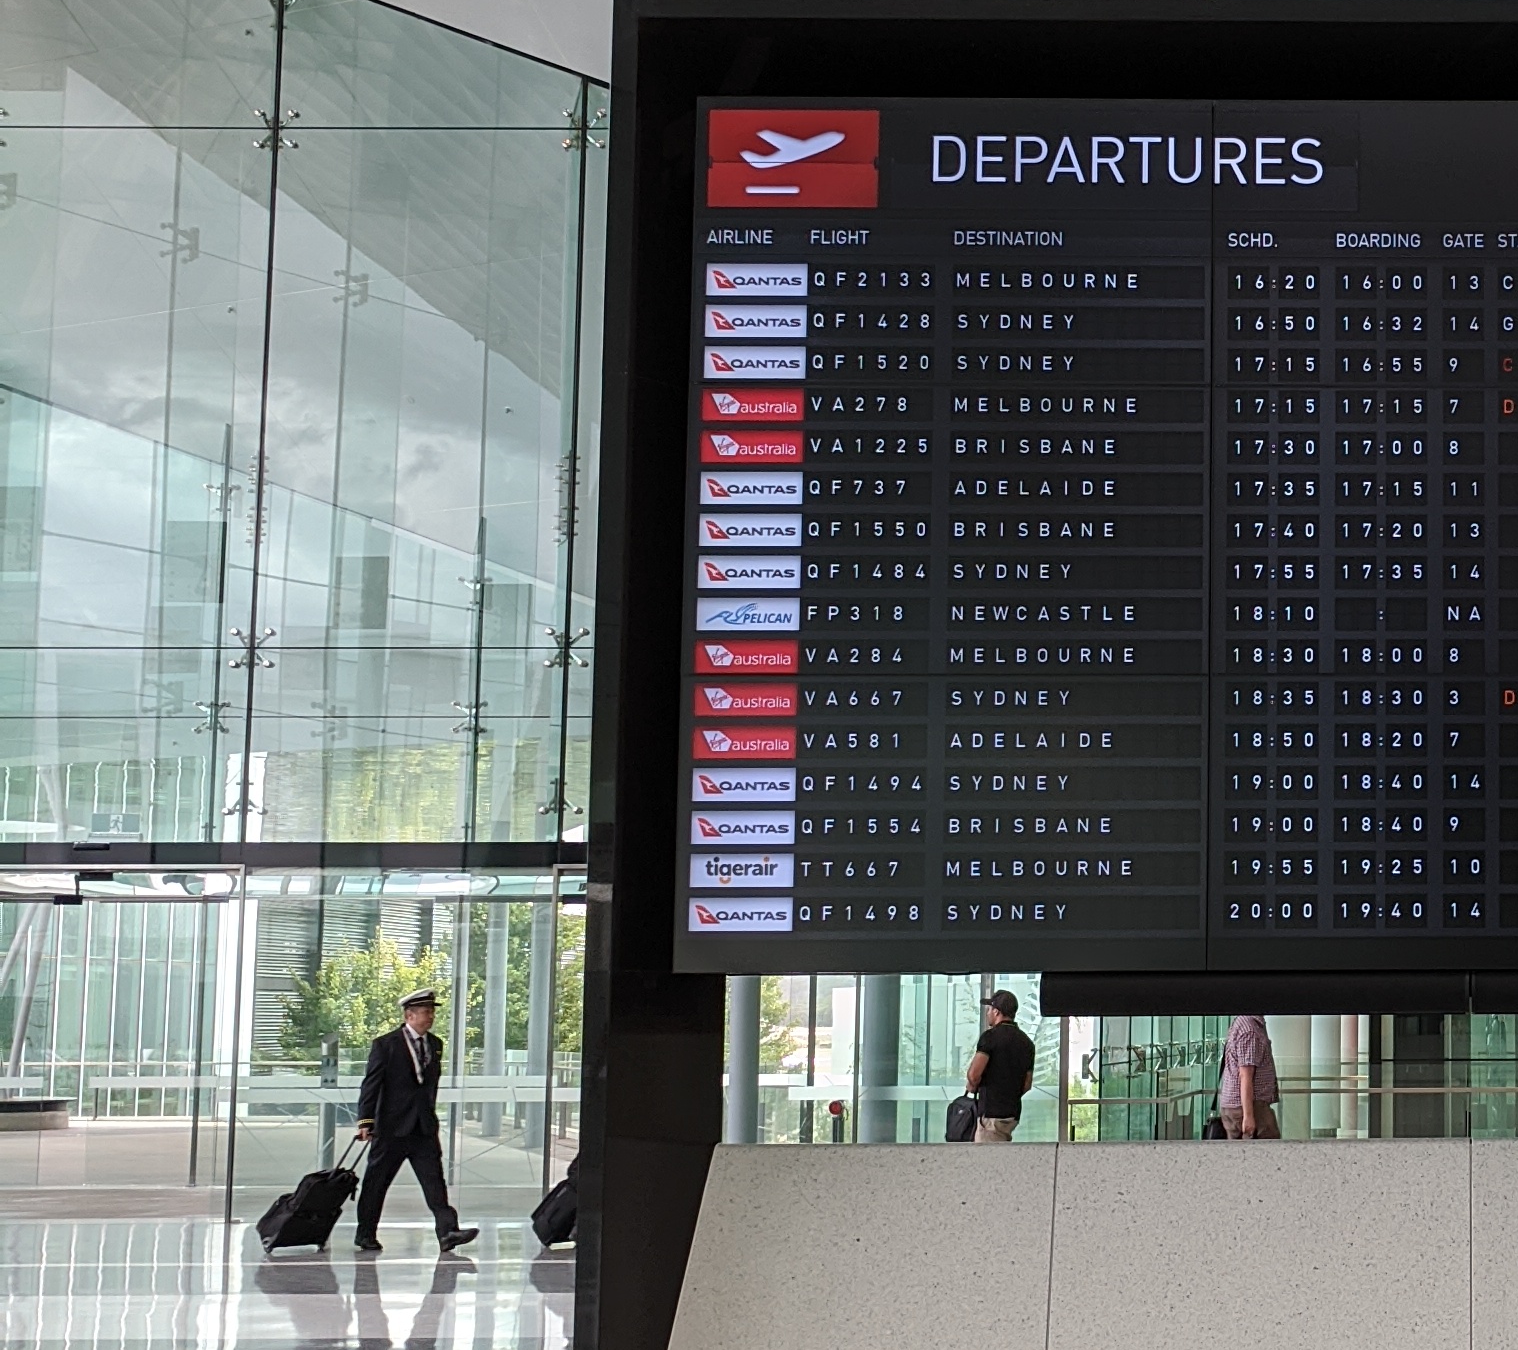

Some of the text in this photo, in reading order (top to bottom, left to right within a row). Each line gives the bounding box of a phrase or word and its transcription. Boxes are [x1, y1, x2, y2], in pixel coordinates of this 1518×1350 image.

[931, 135, 1324, 185] DEPARTURES
[706, 229, 773, 245] AIRLINE
[810, 229, 870, 245] FLIGHT
[954, 230, 1063, 246] DESTINATION
[1228, 232, 1278, 248] SCHD.
[1336, 233, 1421, 248] BOARDING
[1443, 233, 1484, 248] GATE
[733, 275, 803, 287] QANTAS
[814, 271, 930, 287] QF2133
[956, 272, 1138, 289] MELBOURNE
[1235, 274, 1315, 290] 16:20
[1343, 274, 1422, 290] 16:00
[1450, 275, 1479, 290] 13
[731, 316, 802, 329] QANTAS
[813, 312, 930, 329] QF1428
[957, 314, 1074, 329] SYDNEY
[1235, 315, 1315, 331] 16:50
[1343, 316, 1422, 331] 16:32
[1450, 316, 1480, 331] 14
[730, 357, 801, 370] QANTAS
[812, 354, 929, 370] QF1520
[957, 355, 1074, 371] SYDNEY
[1235, 356, 1315, 372] 17:15
[1342, 357, 1422, 372] 16:55
[1449, 357, 1458, 372] 9
[741, 402, 797, 413] australia
[811, 396, 907, 412] VA278
[954, 397, 1137, 413] MELBOURNE
[1235, 398, 1315, 414] 17:15
[1343, 398, 1422, 414] 17:15
[1449, 399, 1459, 414] 7
[740, 443, 796, 455] australia
[810, 438, 927, 453] VA1225
[955, 438, 1115, 454] BRISBANE
[1235, 439, 1315, 455] 17:30
[1343, 440, 1423, 455] 17:00
[1449, 440, 1459, 455] 8
[727, 479, 1478, 497] QANTAS QF737 ADELAIDE 17:35 17:15 11
[725, 521, 1480, 538] QANTAS QF1550 BRISBANE 17:40 17:20 13
[724, 563, 1480, 580] QANTAS QF1484 SYDNEY 17:55 17:35 14
[741, 605, 1481, 626] PELICAN FP318 NEWCASTLE 18:10 NA
[734, 654, 791, 665] australia
[805, 648, 902, 663] VA284
[950, 647, 1134, 663] MELBOURNE
[1233, 647, 1314, 663] 18:30
[1342, 647, 1422, 663] 18:00
[1449, 647, 1459, 663] 8
[733, 696, 790, 708] australia
[804, 690, 902, 706] VA667
[951, 690, 1070, 706] SYDNEY
[1233, 690, 1314, 705] 18:35
[1342, 689, 1423, 705] 18:30
[1449, 689, 1459, 705] 3
[732, 739, 789, 751] australia
[803, 733, 898, 749] VA581
[950, 732, 1112, 748] ADELAIDE
[1233, 732, 1314, 747] 18:50
[1342, 731, 1423, 747] 18:20
[1449, 731, 1459, 747] 7
[719, 774, 1480, 793] QANTAS QF1494 SYDNEY 19:00 18:40 14
[718, 816, 1459, 836] QANTAS QF1554 BRISBANE 19:00 18:40 9
[704, 855, 1480, 884] tigerair TT667 MELBOURNE 19:55 19:25 10
[714, 902, 1481, 923] QANTAS QF1498 SYDNEY 20:00 19:40 14
